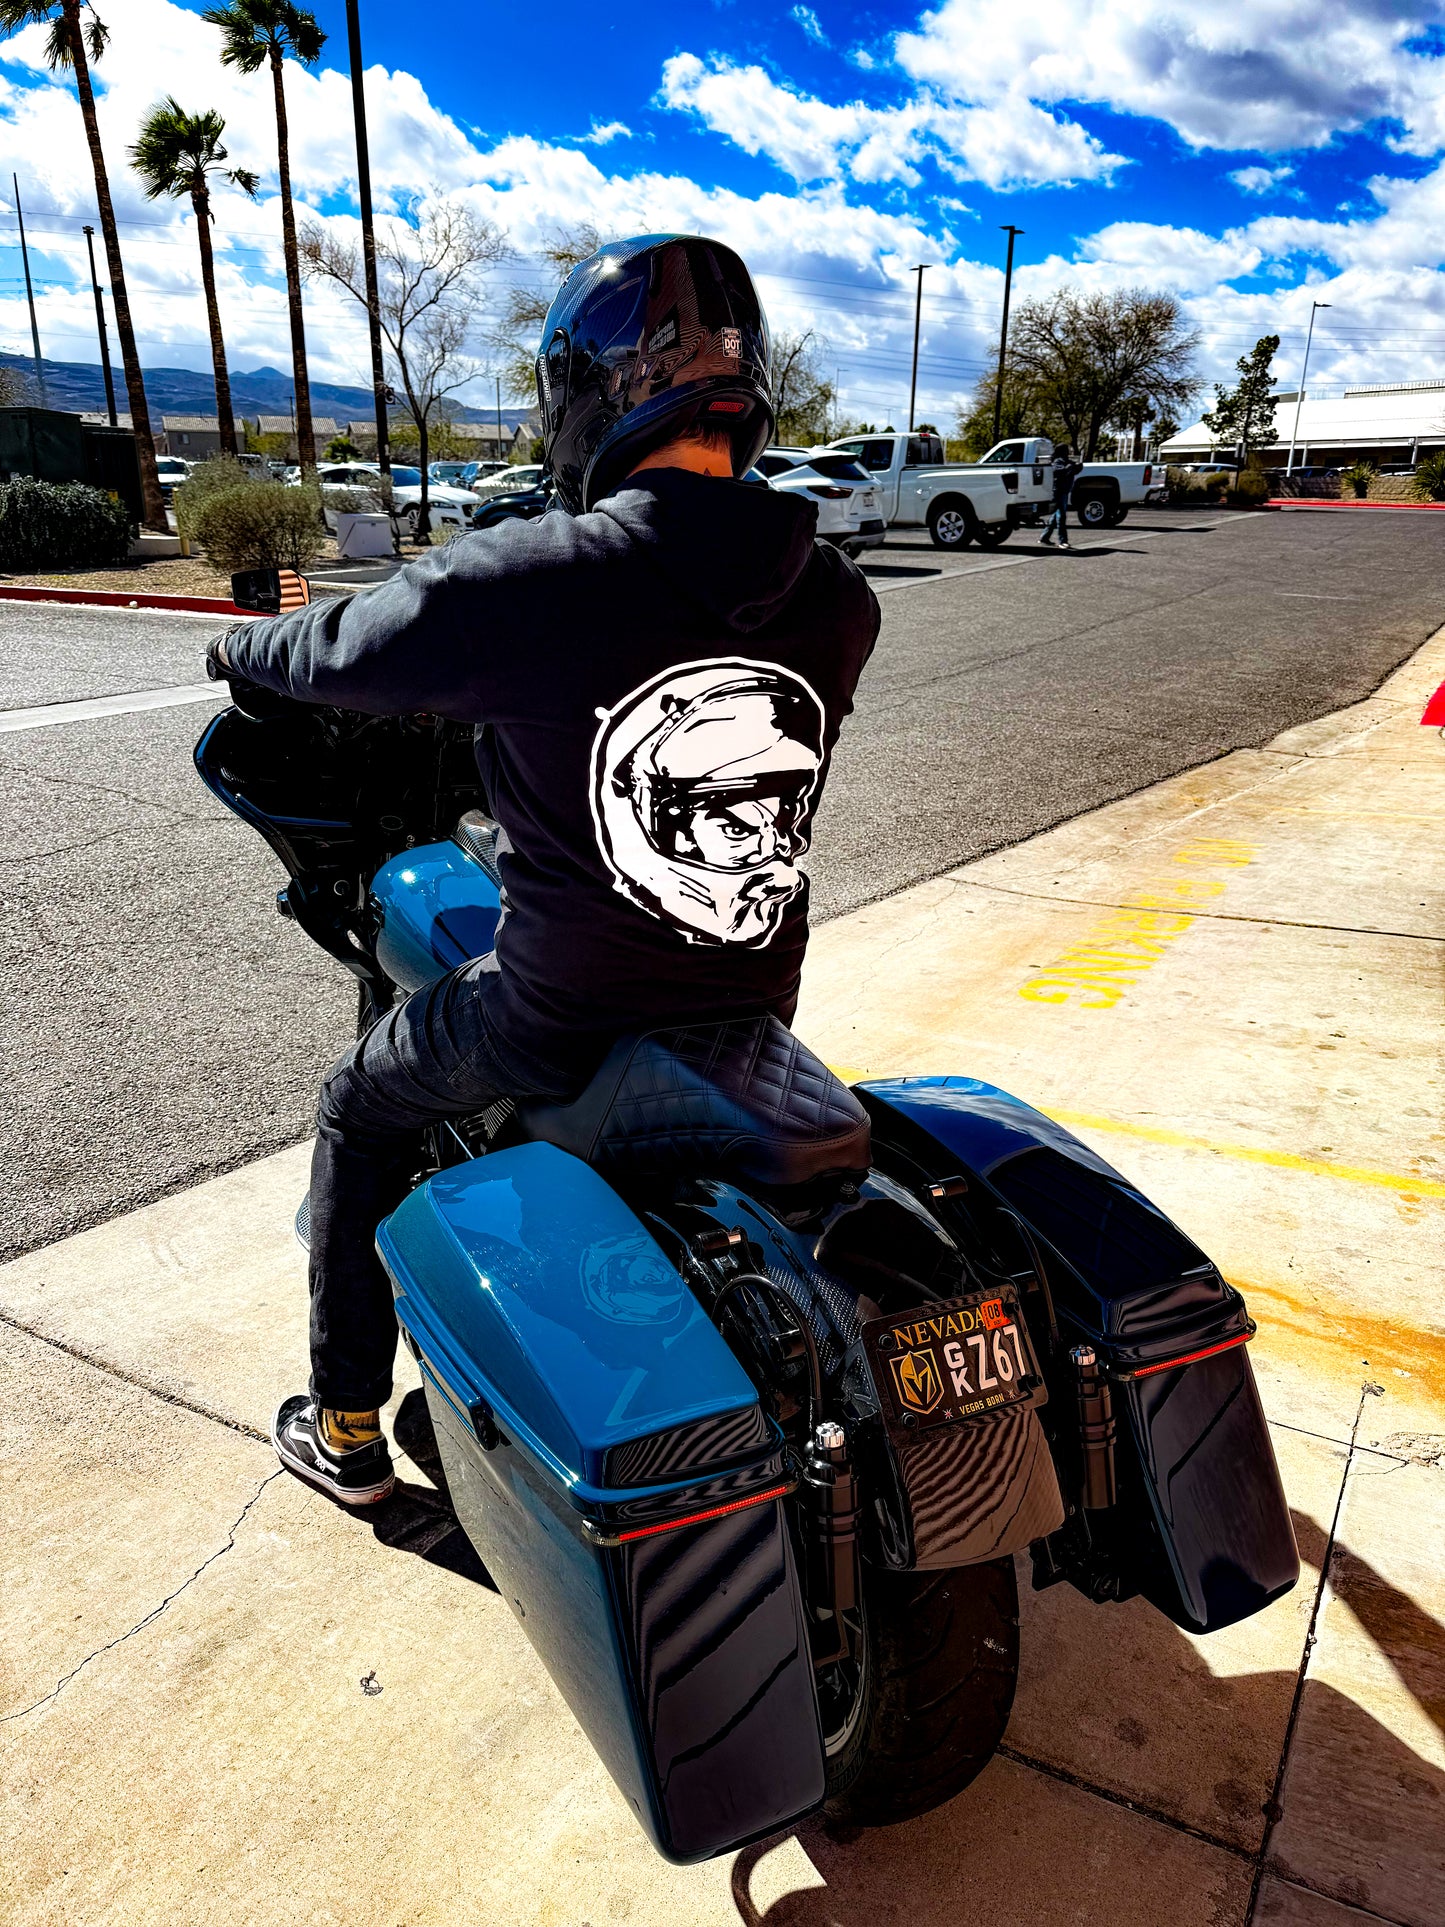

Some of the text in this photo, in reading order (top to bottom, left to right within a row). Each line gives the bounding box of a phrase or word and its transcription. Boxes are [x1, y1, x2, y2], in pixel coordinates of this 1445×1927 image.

[724, 338, 741, 350] DOT
[539, 357, 551, 400] SIMPSON
[1018, 837, 1266, 1009] NO PARKING
[892, 1307, 986, 1350] NEVADA
[987, 1303, 1001, 1320] 08
[966, 1325, 1026, 1390] Z67
[959, 1393, 1005, 1416] VEGAS BORN
